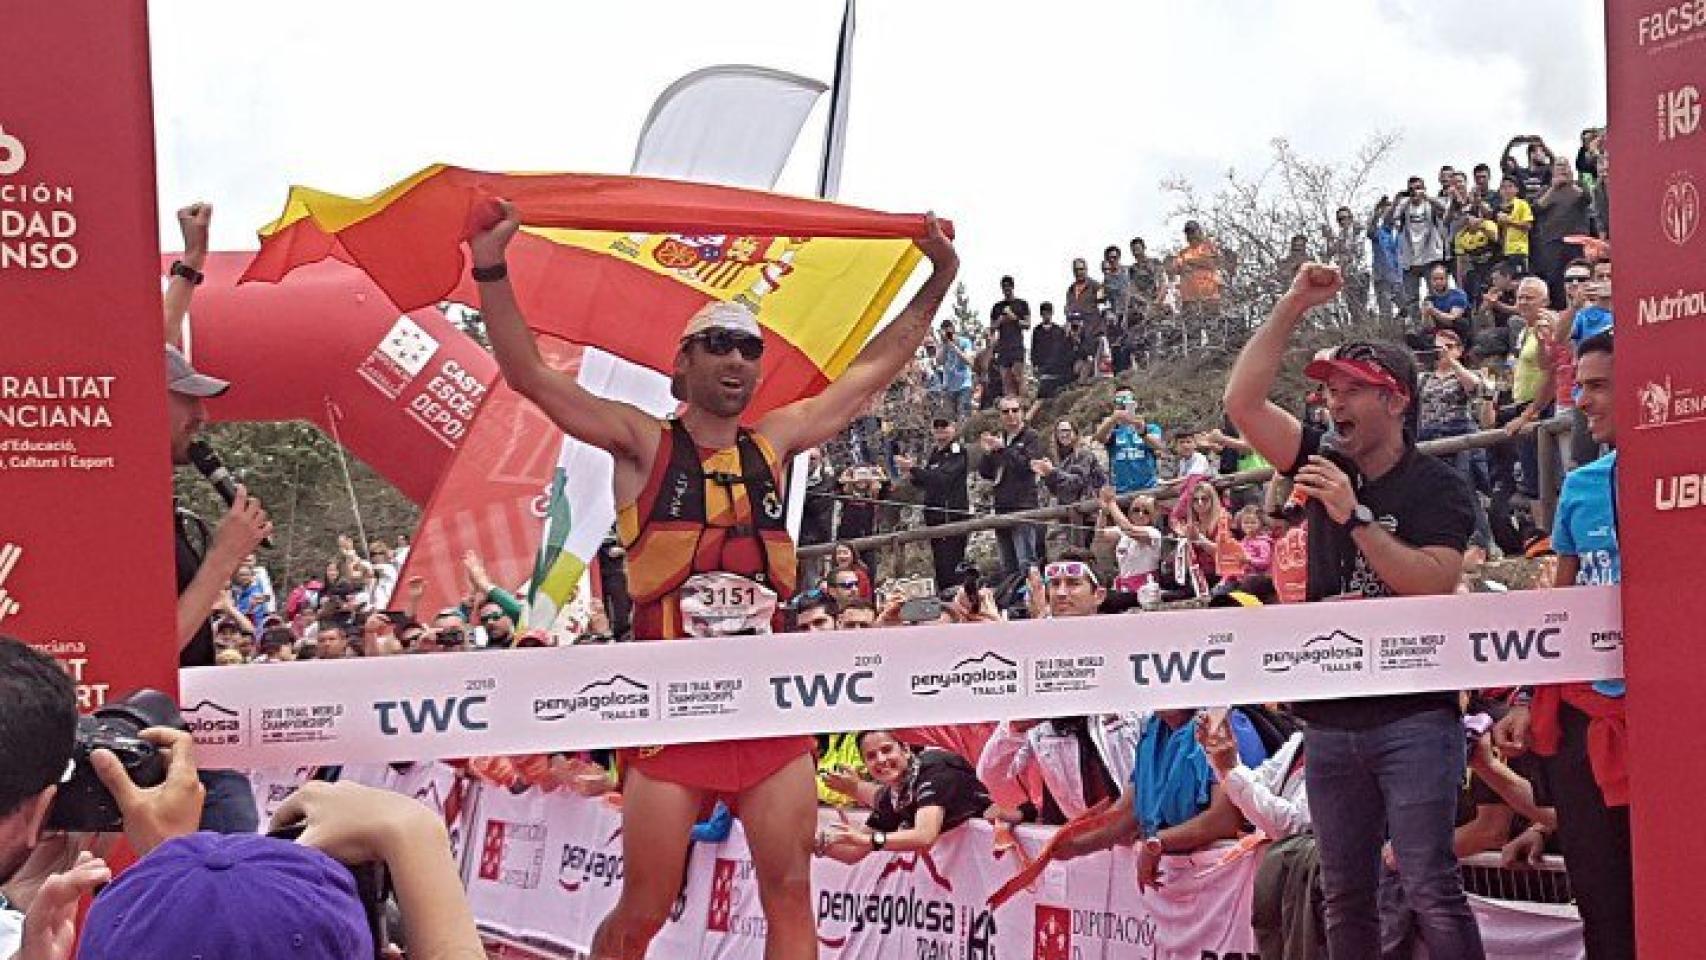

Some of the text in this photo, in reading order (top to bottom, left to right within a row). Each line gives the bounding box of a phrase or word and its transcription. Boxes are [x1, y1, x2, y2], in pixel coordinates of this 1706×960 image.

[1, 183, 73, 203] CIÓN
[2, 210, 77, 238] DAD
[2, 241, 78, 269] NSO
[2, 376, 116, 399] RALITAT
[1656, 473, 1706, 510] UB
[702, 587, 755, 605] 3151
[1468, 627, 1561, 662] TWC
[911, 668, 1017, 690] penyagolosa
[1129, 649, 1226, 686] TWC
[465, 678, 496, 690] 2018
[770, 670, 875, 709] TWC
[374, 695, 489, 735] TWC
[533, 691, 650, 714] penyagolosa
[818, 886, 956, 934] penyagolosa
